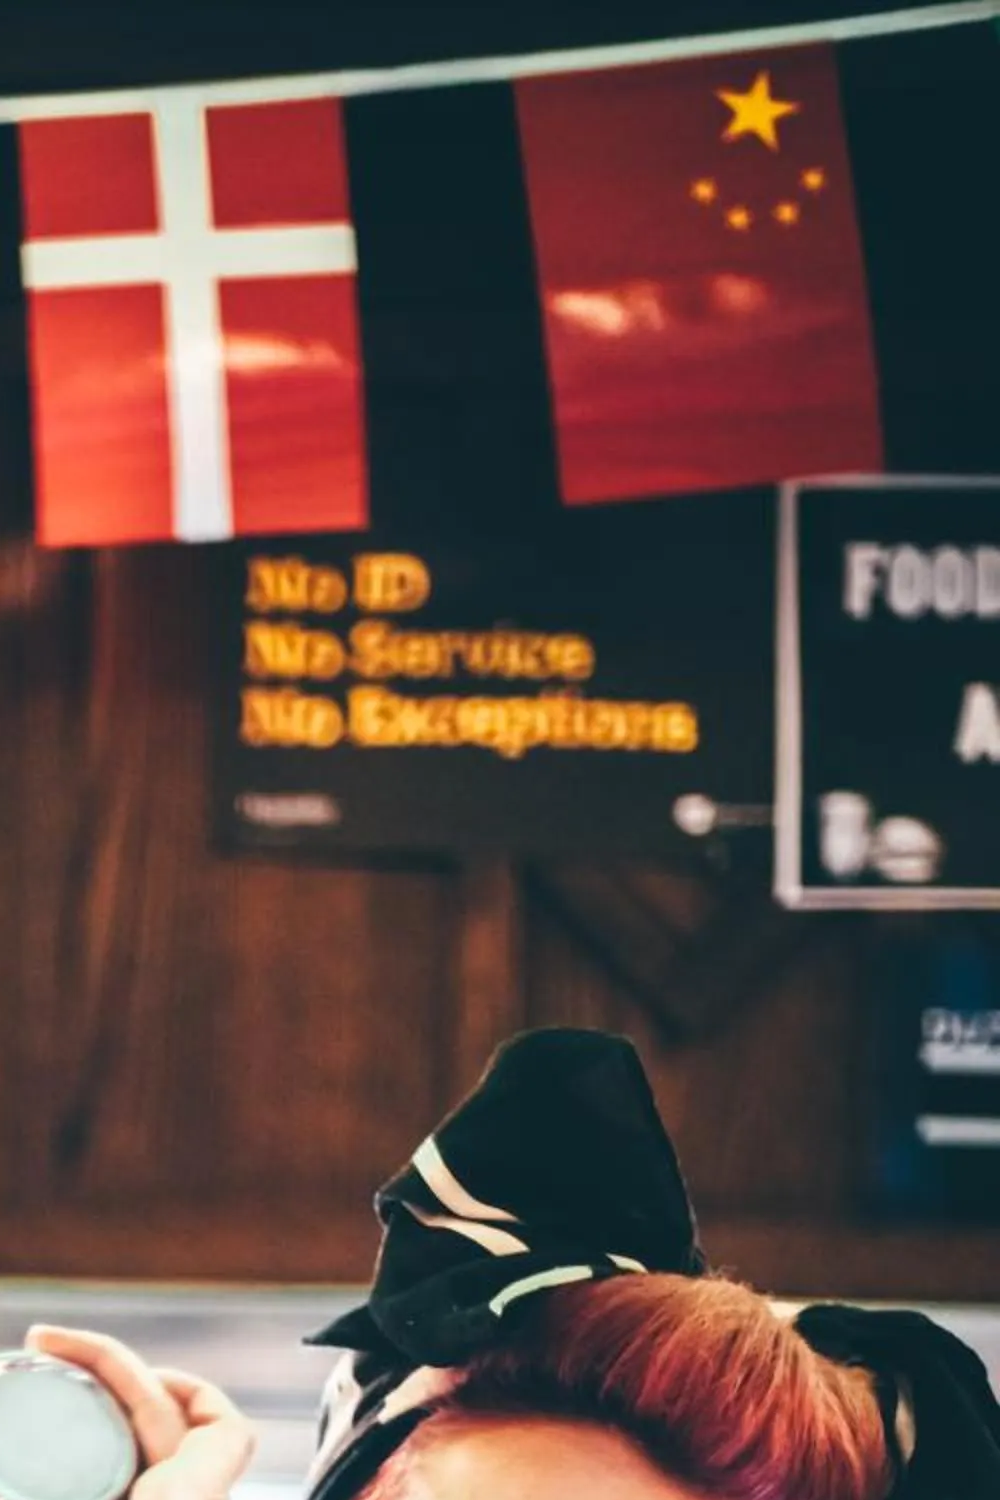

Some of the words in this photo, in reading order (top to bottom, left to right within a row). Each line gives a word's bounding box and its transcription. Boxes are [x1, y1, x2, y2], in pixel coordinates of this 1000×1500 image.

[247, 555, 347, 613] No
[353, 553, 431, 612] ID
[245, 620, 345, 679] No
[349, 620, 595, 681] Service
[241, 687, 344, 747] No
[348, 686, 698, 758] Exceptions
